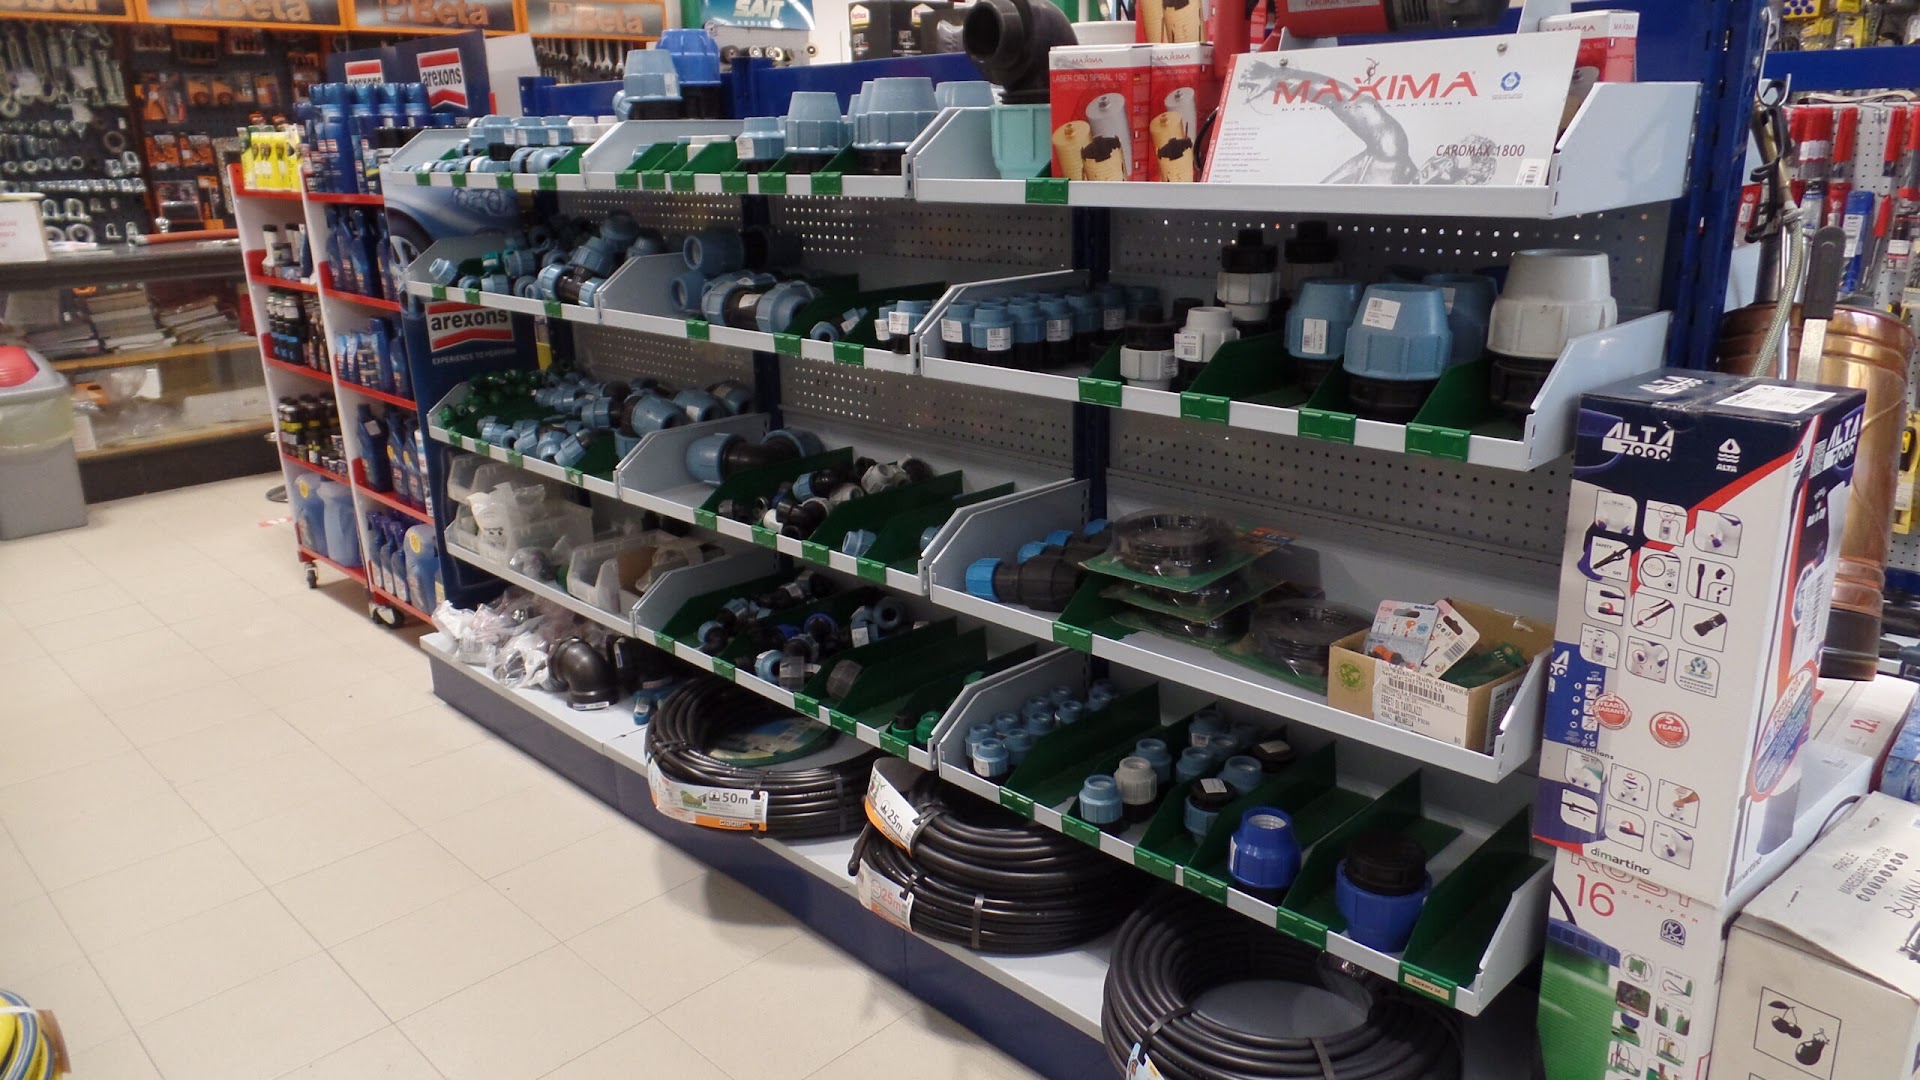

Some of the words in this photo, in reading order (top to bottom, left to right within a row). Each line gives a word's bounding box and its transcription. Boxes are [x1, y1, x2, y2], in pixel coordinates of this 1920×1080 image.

[411, 0, 490, 25] Beta
[570, 9, 645, 34] Beta
[420, 66, 463, 88] arexons
[1272, 71, 1478, 105] MAXIMA
[1436, 144, 1492, 157] CAROMAX
[1496, 144, 1525, 157] 1800
[431, 310, 508, 332] arexons
[1606, 421, 1675, 447] ALTA
[1715, 463, 1738, 473] ALTA
[1657, 723, 1682, 733] YEARS
[1664, 716, 1675, 724] 5
[721, 792, 749, 805] 50m
[886, 809, 904, 832] 25m
[1590, 846, 1651, 876] dimartino
[880, 889, 901, 911] 25m
[1576, 873, 1615, 918] 16
[1621, 888, 1699, 924] SPRAYER
